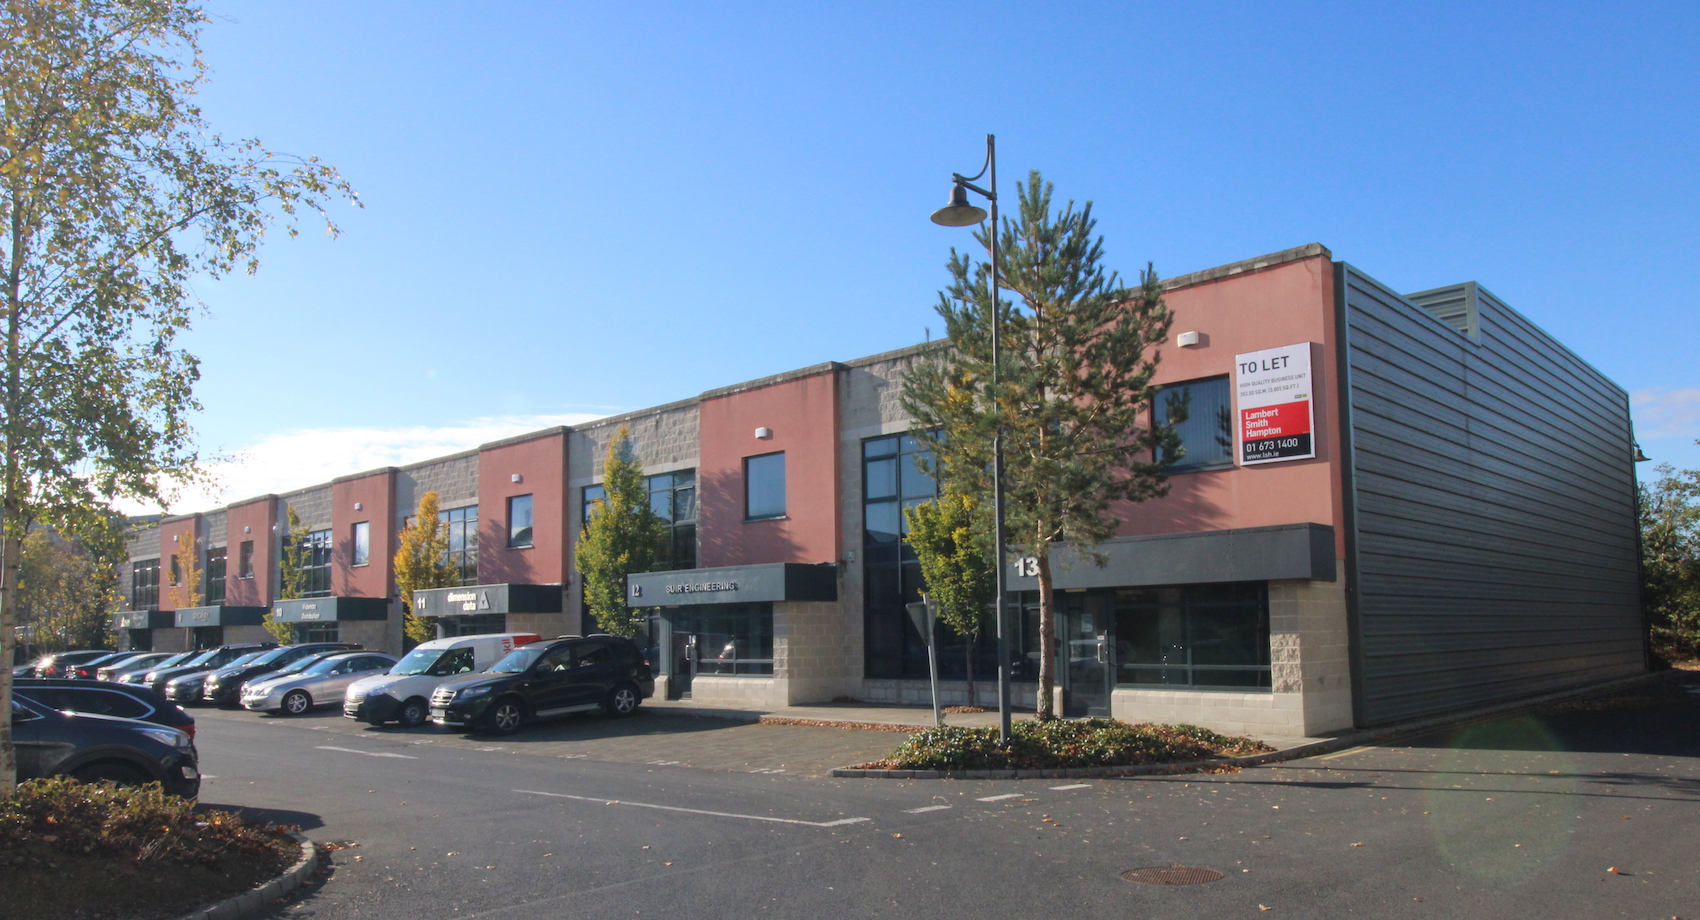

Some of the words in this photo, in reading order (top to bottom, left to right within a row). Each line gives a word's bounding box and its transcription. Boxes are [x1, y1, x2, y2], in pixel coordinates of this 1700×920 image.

[1239, 361, 1257, 375] TO
[1262, 355, 1289, 371] LET
[1251, 378, 1270, 386] QUALITY
[1271, 374, 1294, 383] BUSINESS
[1245, 408, 1279, 420] Lambert
[1245, 418, 1268, 429] Smith
[1245, 426, 1282, 438] Hampton
[1246, 443, 1256, 452] 01
[1259, 440, 1274, 450] 673
[1277, 438, 1298, 448] 1400
[1247, 450, 1279, 460] www.lsh.ie
[1014, 557, 1039, 576] 13
[631, 585, 640, 597] 12
[665, 584, 682, 594] SUIR
[685, 581, 735, 592] ENGINEERING
[417, 597, 426, 609] 11
[447, 592, 476, 602] dimension
[463, 601, 476, 611] data
[276, 607, 283, 618] 10
